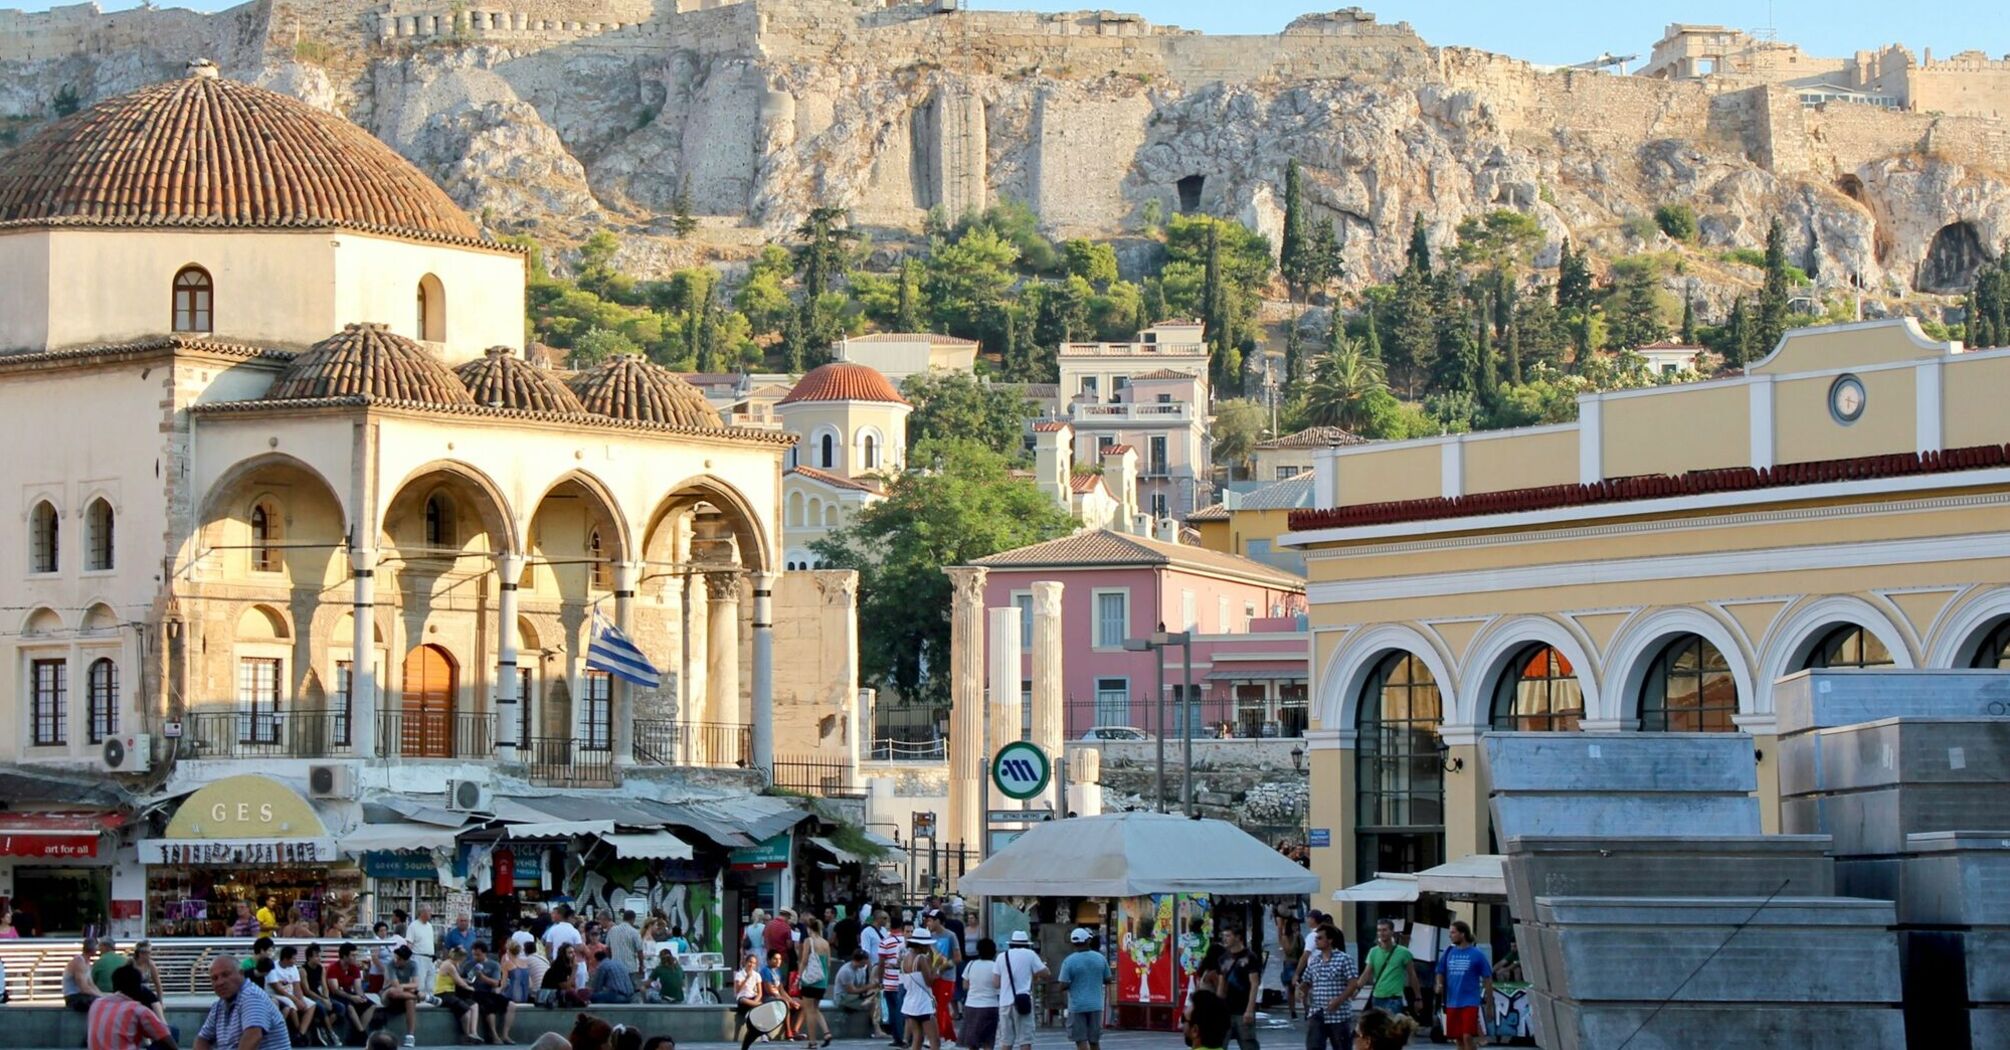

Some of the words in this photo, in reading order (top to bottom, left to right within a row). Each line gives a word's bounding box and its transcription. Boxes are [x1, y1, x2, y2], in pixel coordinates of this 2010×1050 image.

[212, 803, 272, 822] GES
[44, 845, 59, 854] art
[60, 844, 75, 854] for
[77, 845, 89, 854] all
